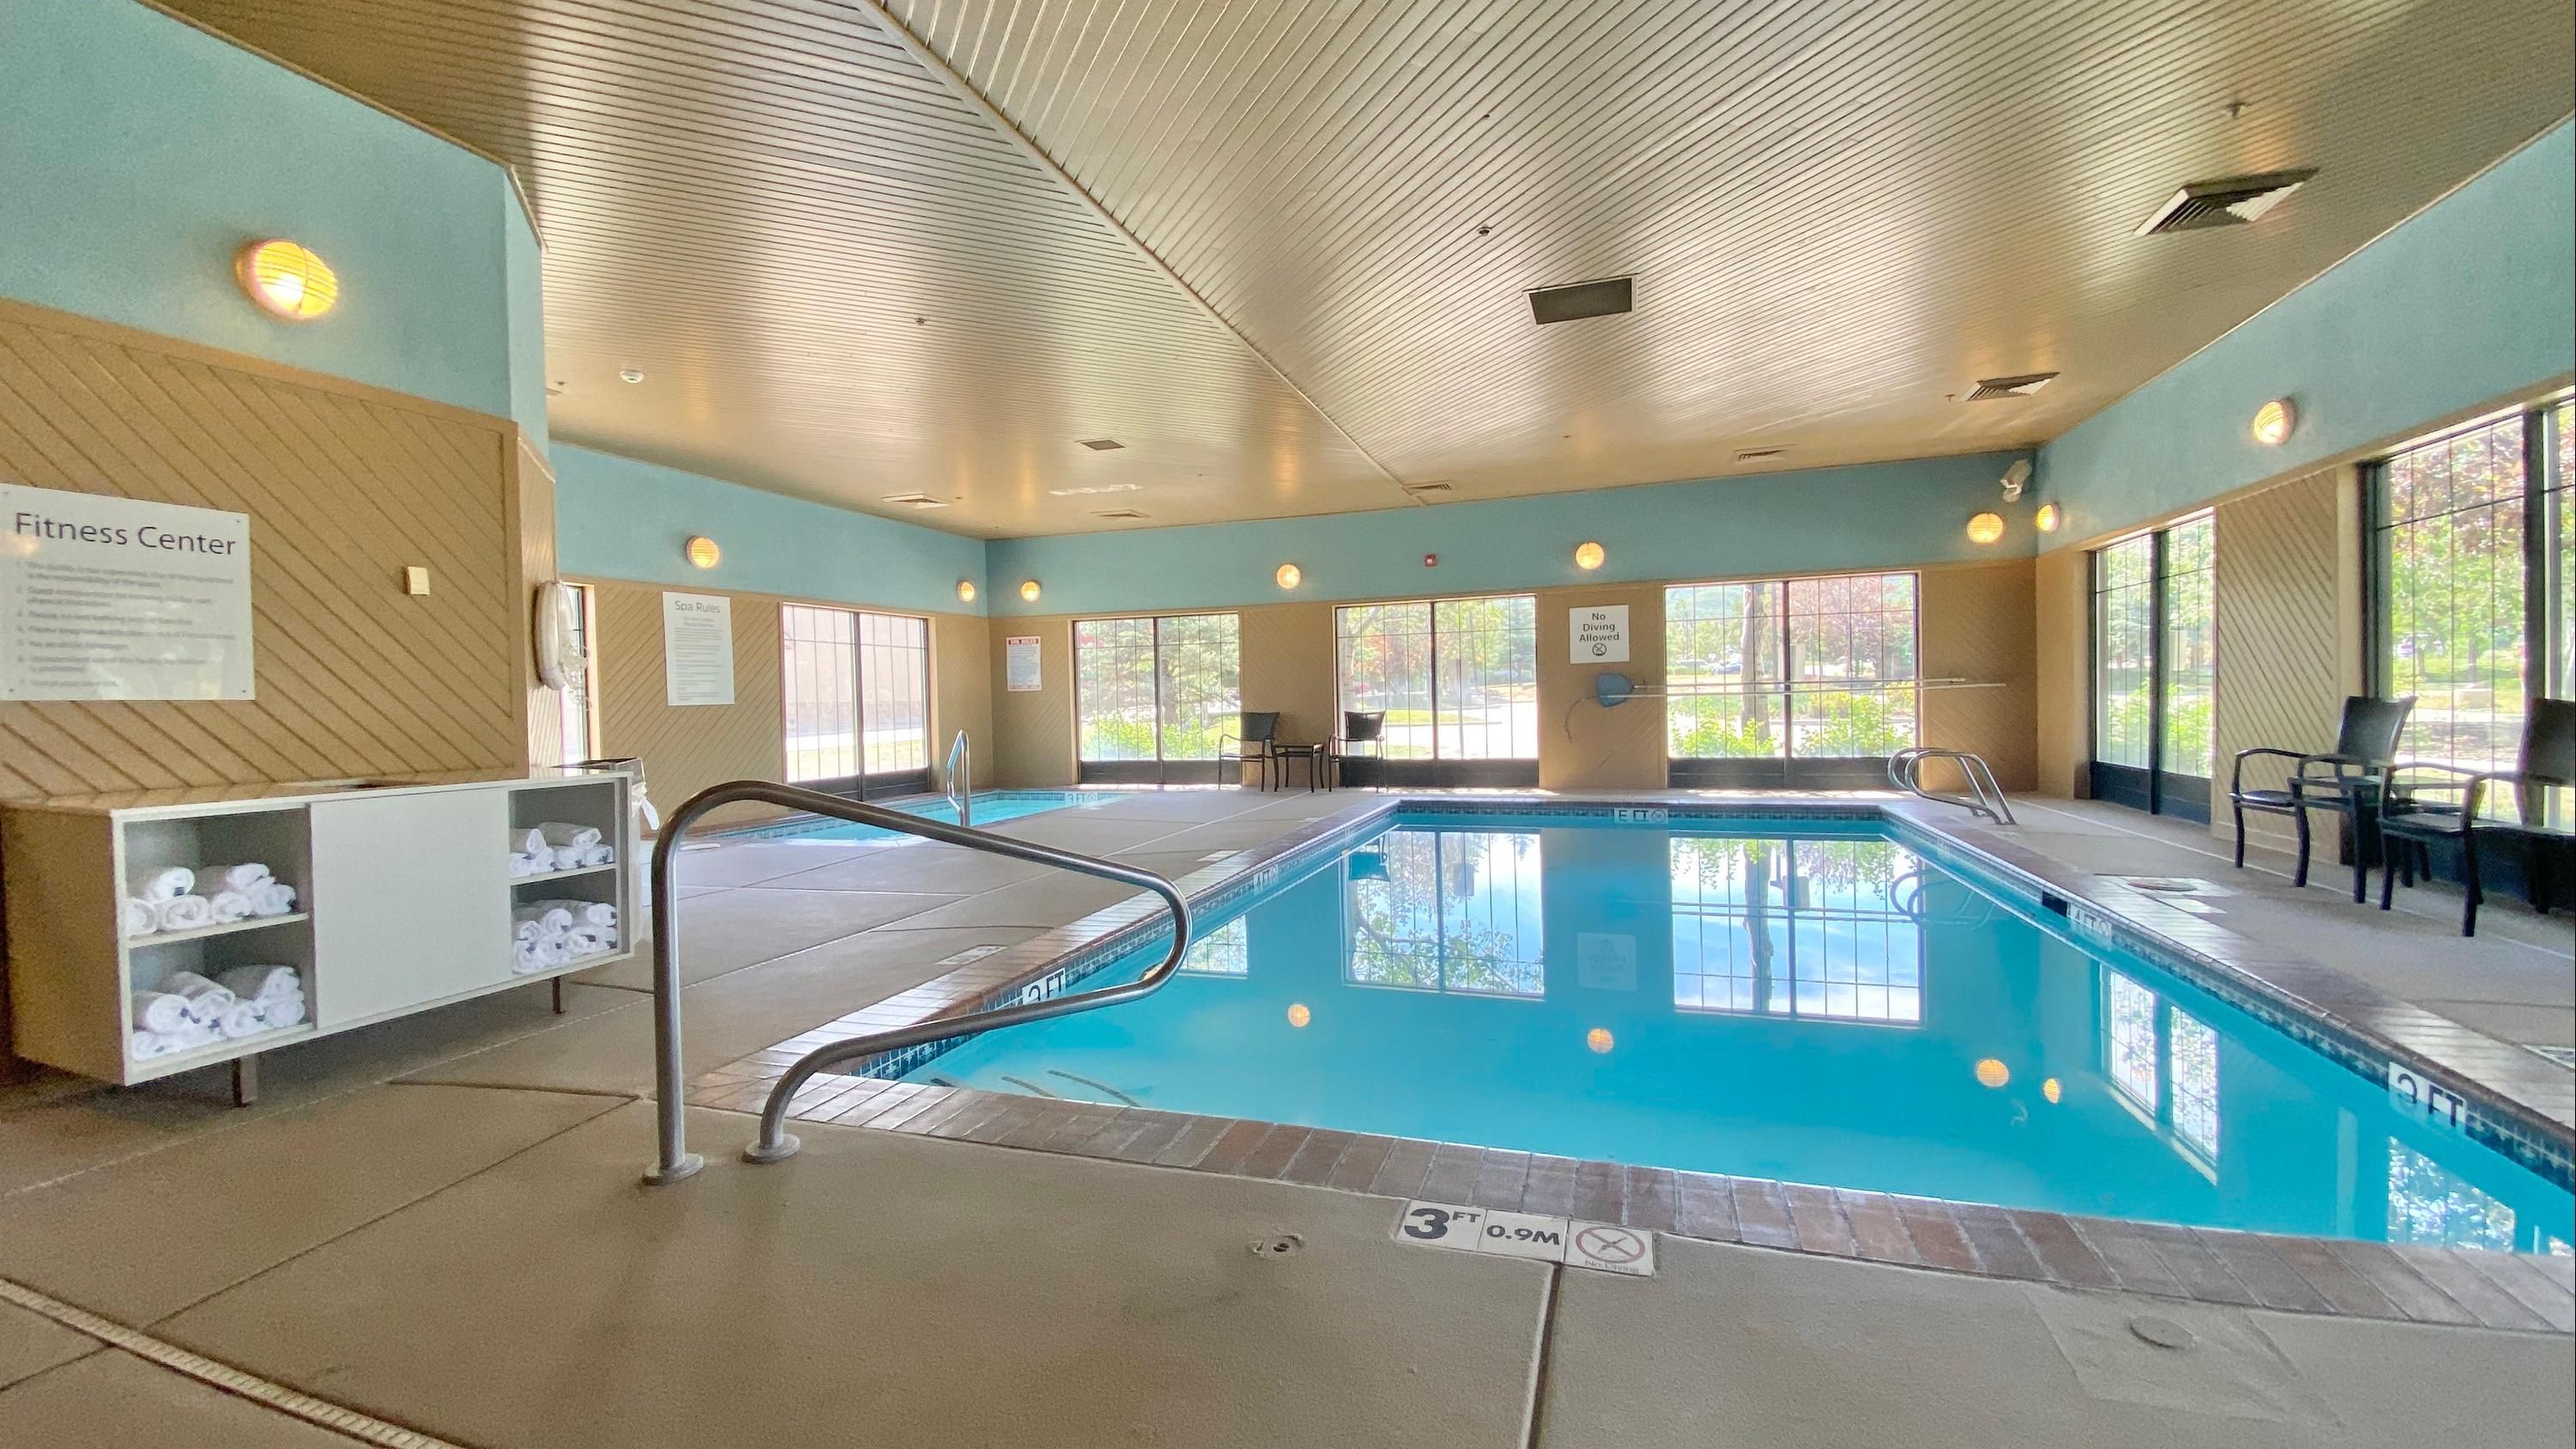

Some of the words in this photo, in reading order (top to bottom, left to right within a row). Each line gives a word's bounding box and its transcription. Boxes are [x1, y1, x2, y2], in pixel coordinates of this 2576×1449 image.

[15, 512, 128, 545] Fitness
[137, 526, 236, 555] Center
[674, 600, 693, 612] Spa
[696, 602, 720, 613] Rules
[1583, 623, 1615, 632] Diving
[1579, 631, 1619, 642] Allowed
[1403, 1208, 1449, 1239] 3
[1452, 1211, 1480, 1222] FT
[1486, 1225, 1559, 1245] 0.9M
